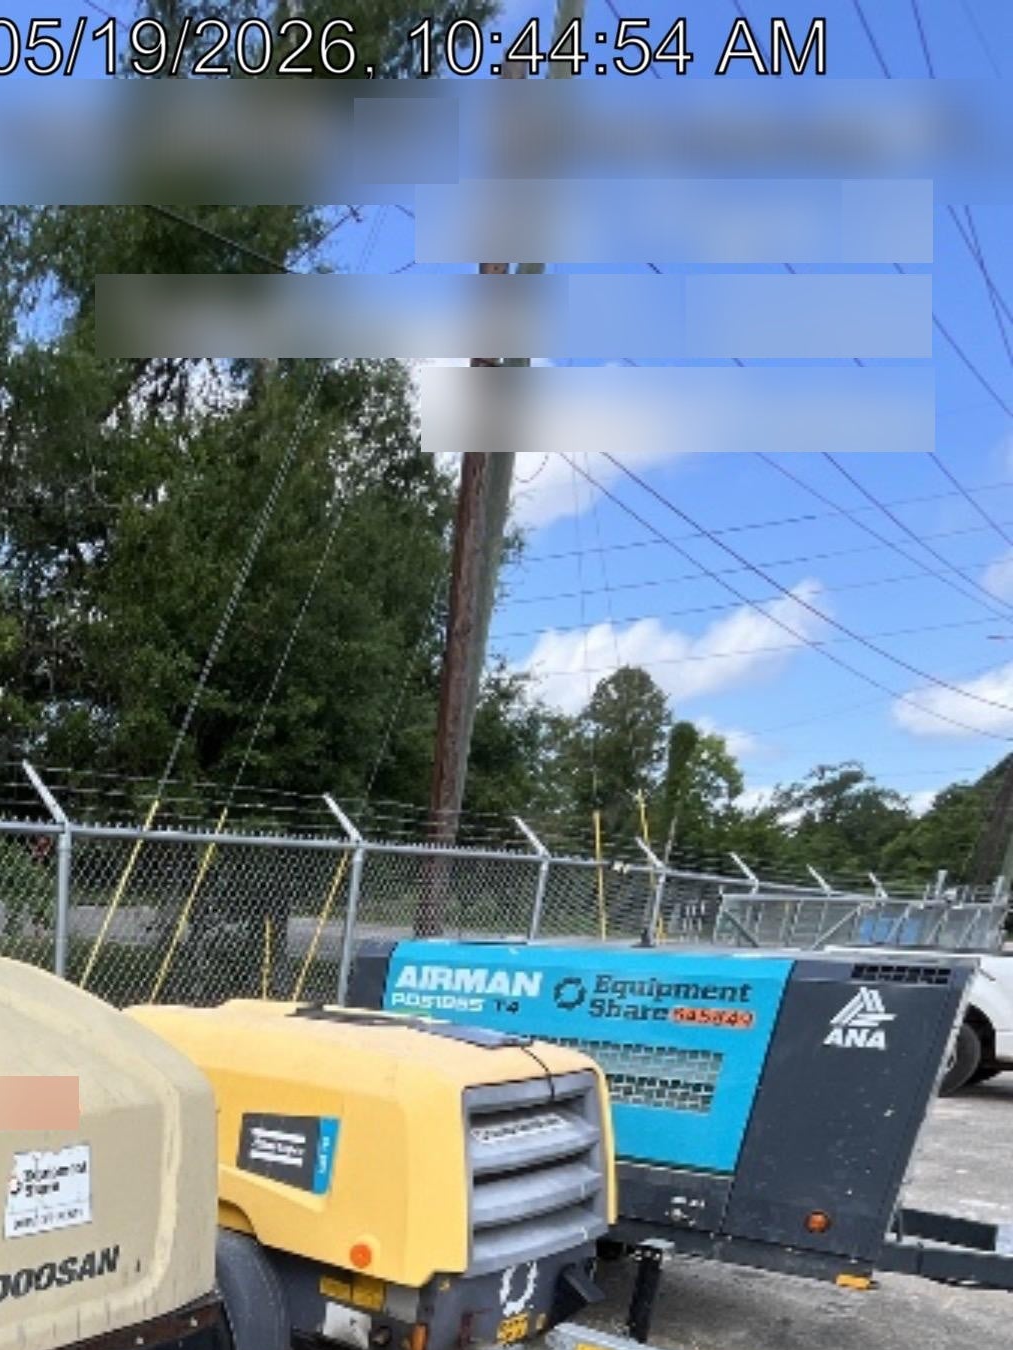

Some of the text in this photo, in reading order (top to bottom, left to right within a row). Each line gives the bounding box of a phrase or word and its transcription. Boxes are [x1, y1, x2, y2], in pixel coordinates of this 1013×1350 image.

[395, 965, 542, 998] AIRMAN
[593, 974, 753, 1003] Equipment
[589, 998, 669, 1021] Share
[822, 1027, 888, 1051] ANA
